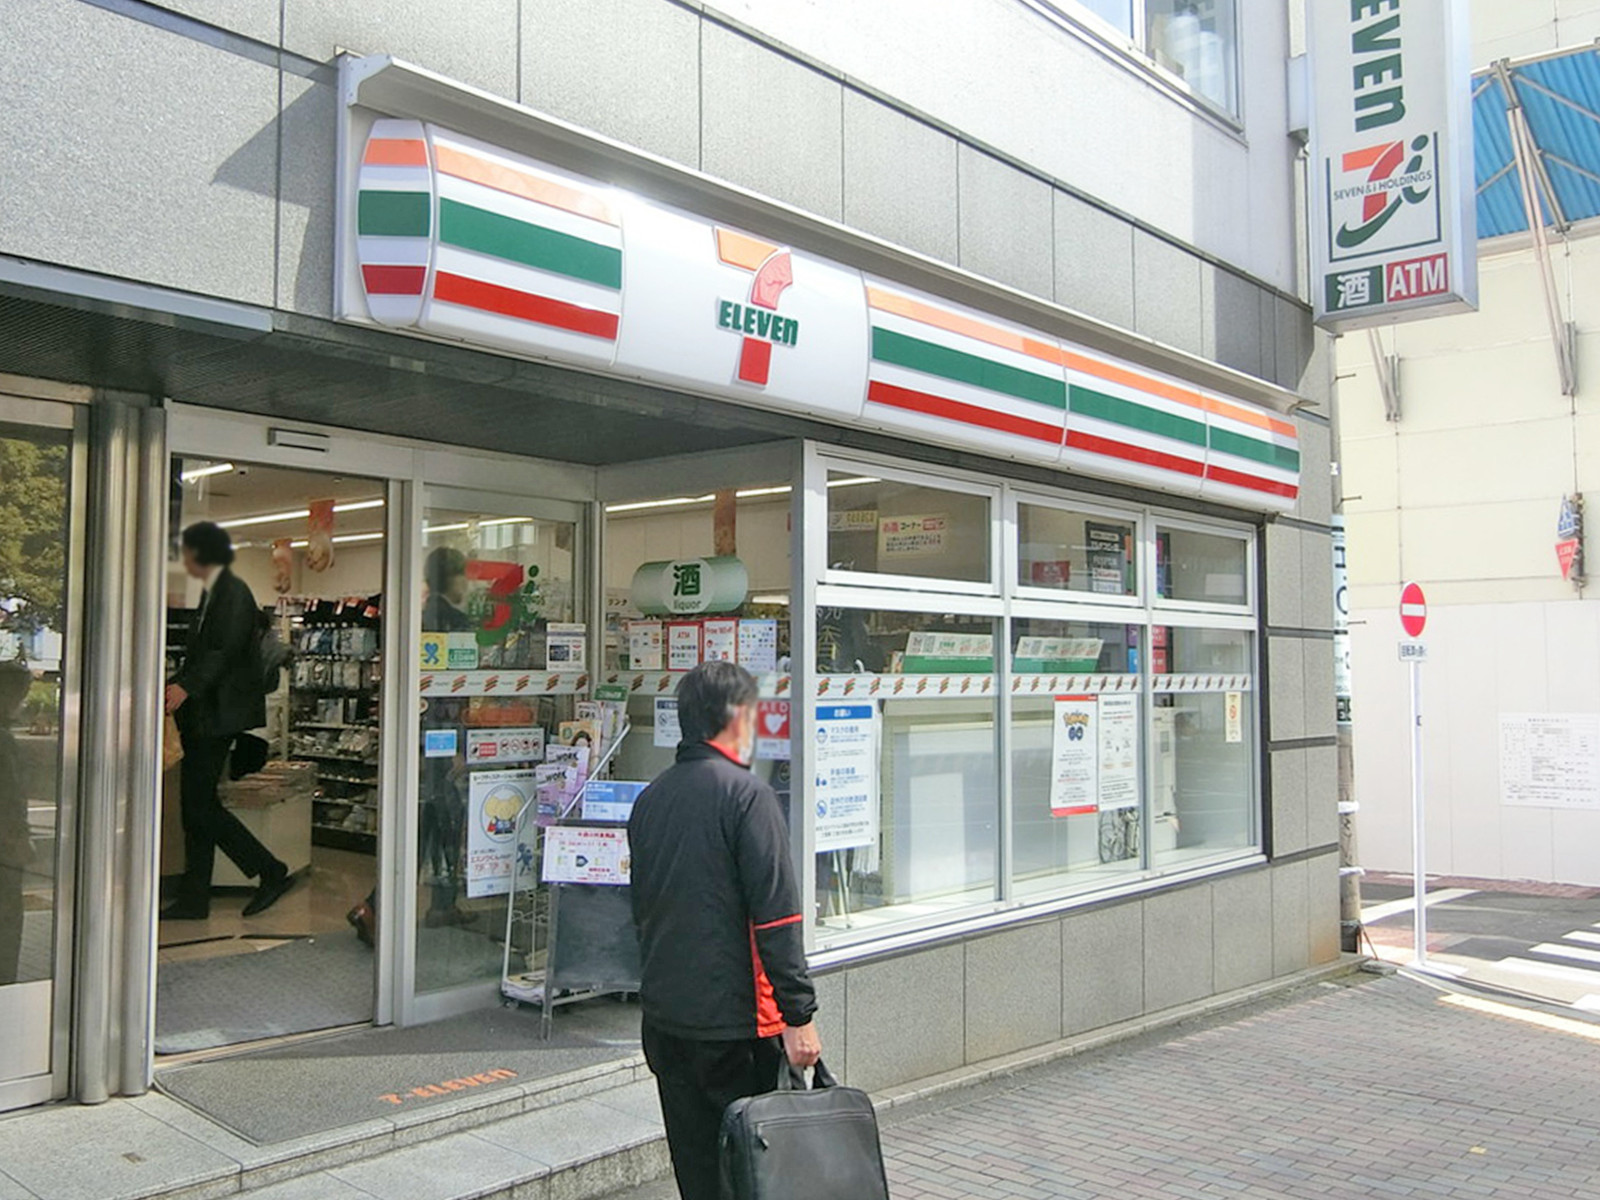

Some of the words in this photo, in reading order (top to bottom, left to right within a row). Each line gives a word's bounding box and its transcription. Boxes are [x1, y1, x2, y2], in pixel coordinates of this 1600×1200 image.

[1379, 170, 1432, 190] HOLDINGS
[1337, 270, 1371, 309] 酒
[1389, 258, 1446, 299] ATM
[672, 563, 701, 597] 酒
[673, 600, 703, 612] liquor
[760, 701, 789, 713] AED
